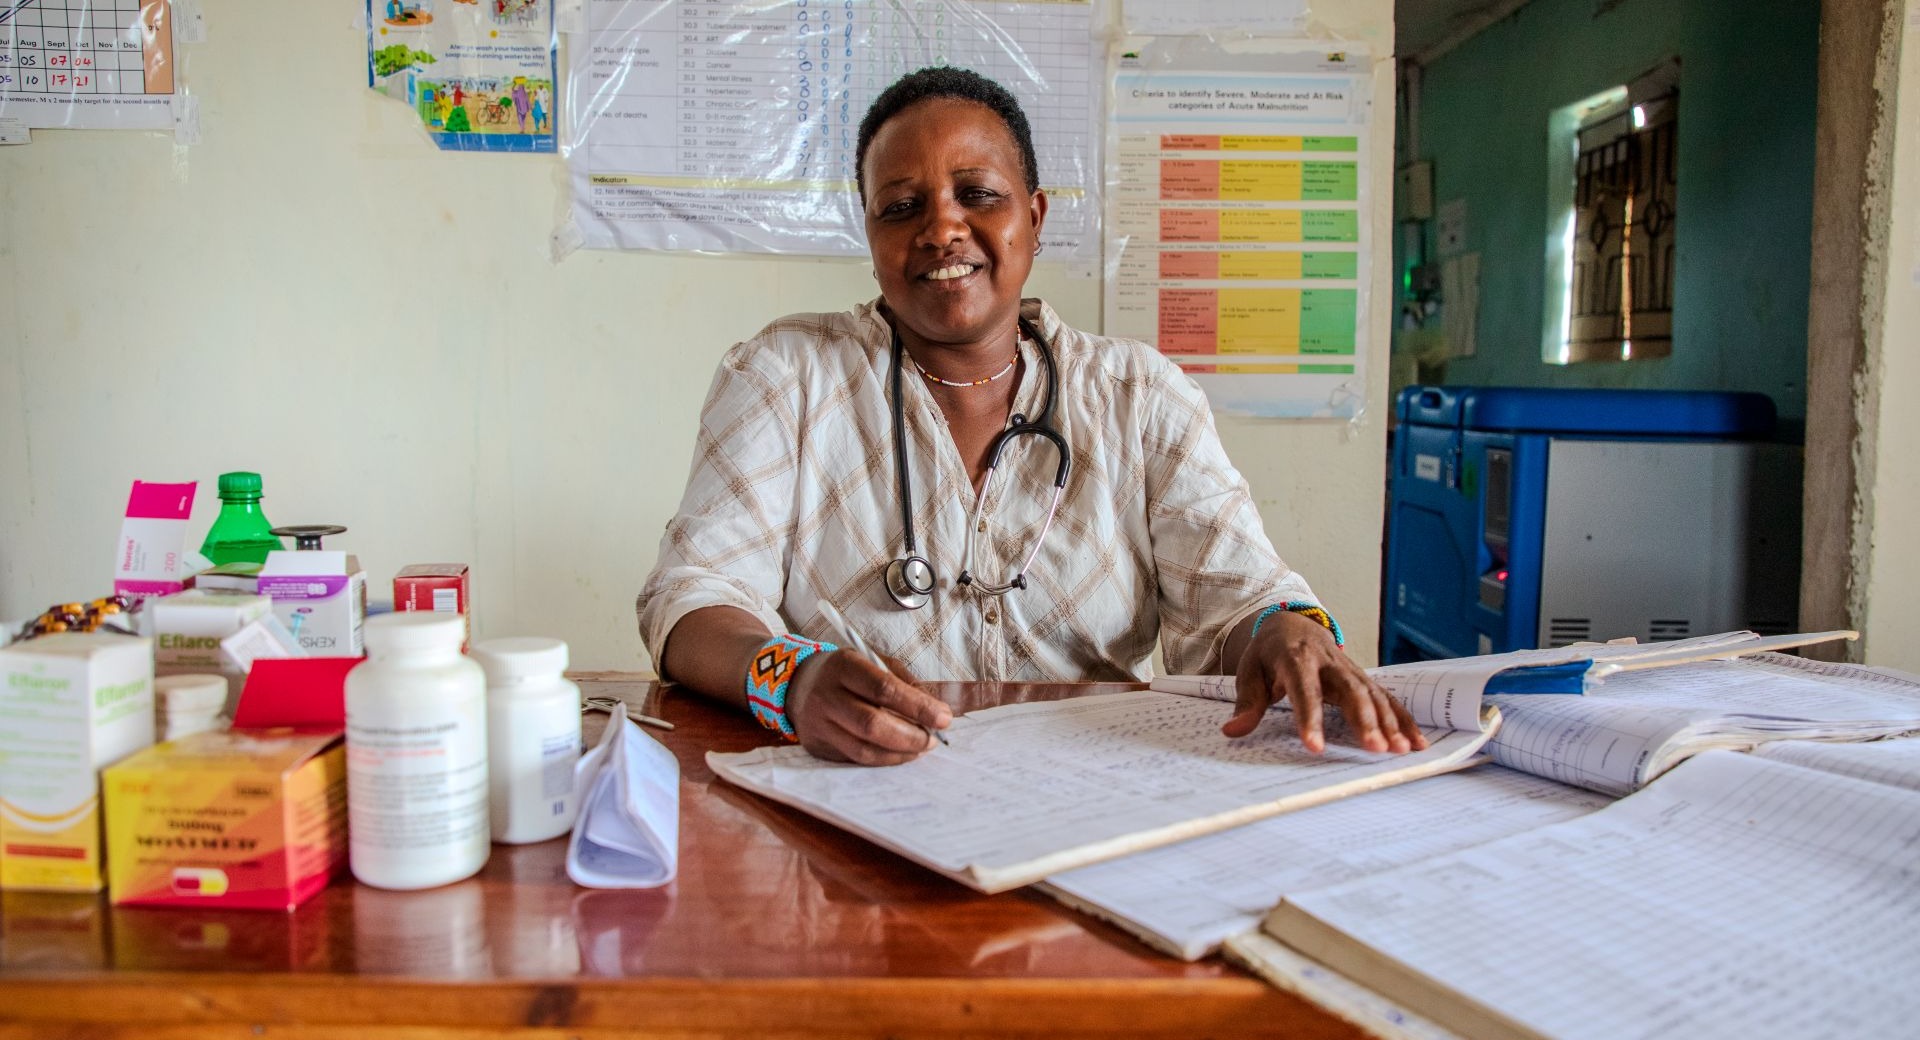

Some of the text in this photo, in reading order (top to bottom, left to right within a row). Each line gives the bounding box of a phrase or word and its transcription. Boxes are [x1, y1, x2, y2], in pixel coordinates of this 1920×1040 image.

[20, 40, 37, 48] Aug
[50, 55, 66, 66] 07
[74, 56, 91, 66] 04
[26, 76, 38, 85] 10
[52, 74, 68, 86] 17
[74, 76, 88, 86] 21
[1167, 90, 1175, 98] to
[1179, 89, 1212, 100] identify
[1251, 90, 1290, 100] Moderate
[1294, 91, 1310, 100] and
[1313, 92, 1323, 100] At
[1325, 92, 1344, 100] Risk
[1168, 101, 1309, 112] categories of Acute Malnutrition
[164, 552, 176, 573] 200
